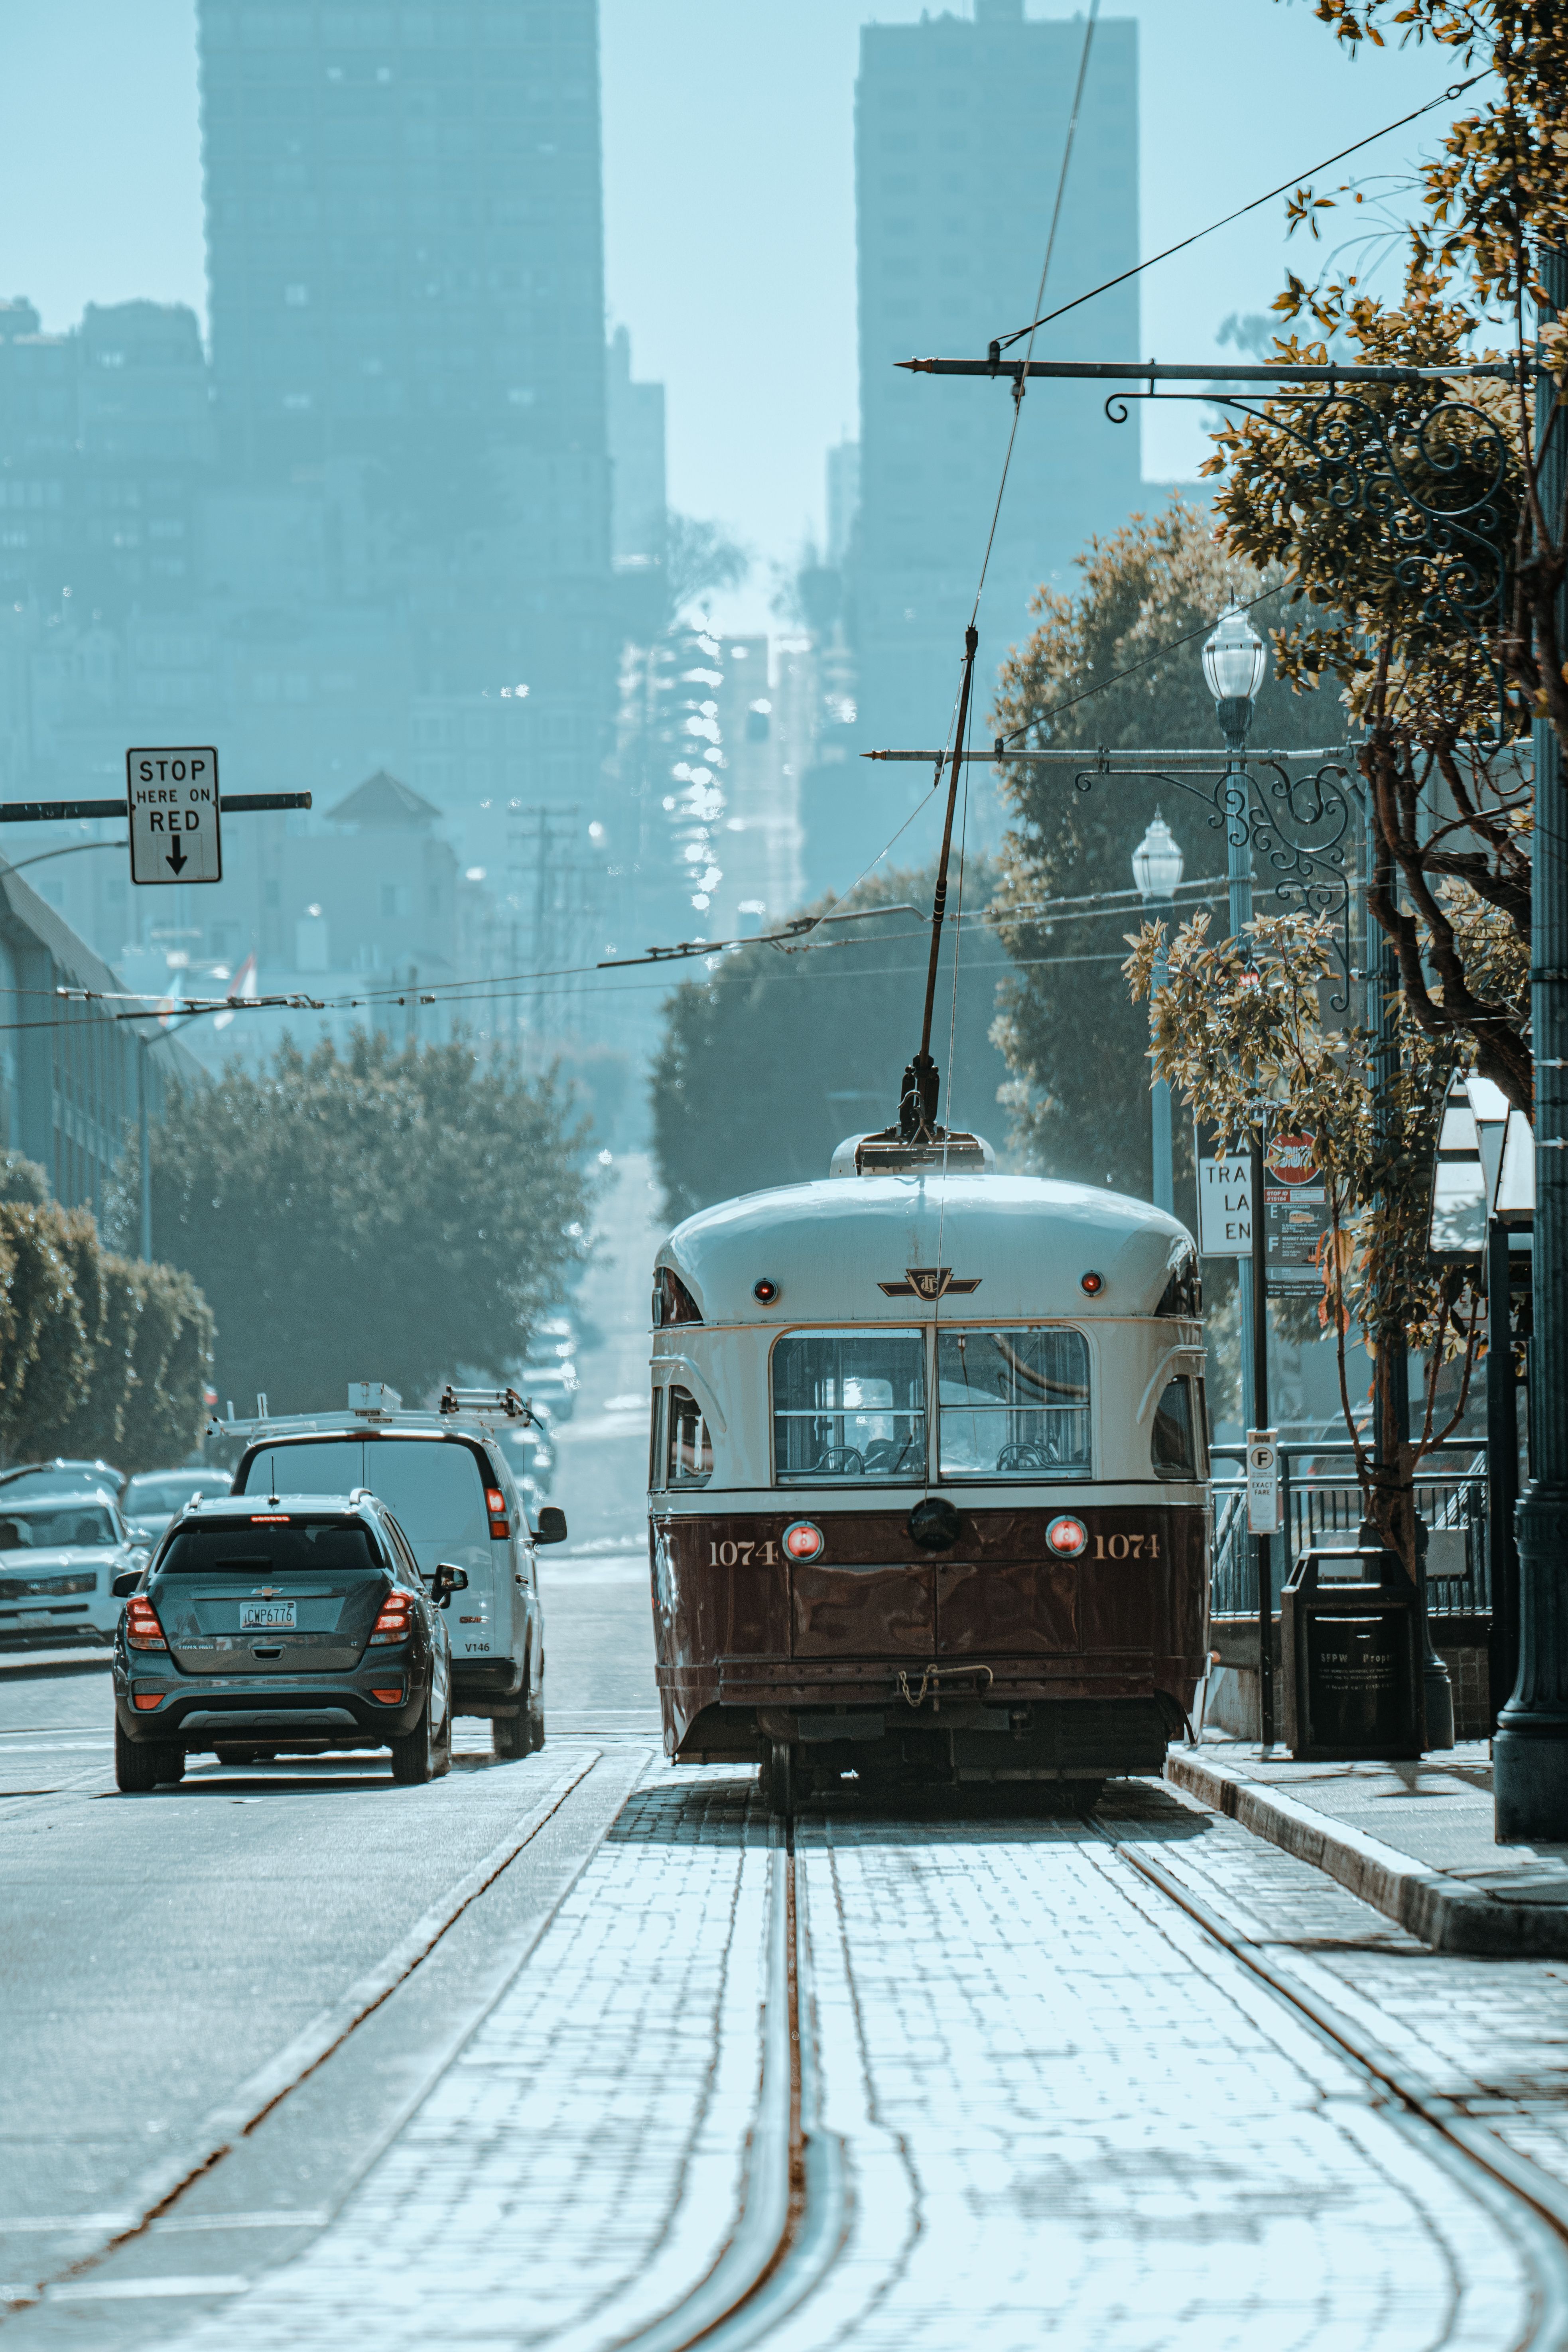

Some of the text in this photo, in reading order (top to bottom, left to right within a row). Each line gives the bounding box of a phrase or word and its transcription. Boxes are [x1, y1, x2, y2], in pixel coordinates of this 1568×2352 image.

[140, 760, 205, 782] STOP
[137, 789, 210, 803] HERE ON
[150, 811, 199, 831] RED
[1206, 1166, 1252, 1183] TRA
[1271, 1205, 1278, 1218] E
[1269, 1237, 1279, 1252] F
[1271, 1269, 1276, 1279] L
[1258, 1452, 1267, 1466] F
[709, 1541, 778, 1566] 1074
[1092, 1534, 1160, 1560] 1074
[248, 1609, 292, 1622] CWP6776
[465, 1643, 490, 1652] V146
